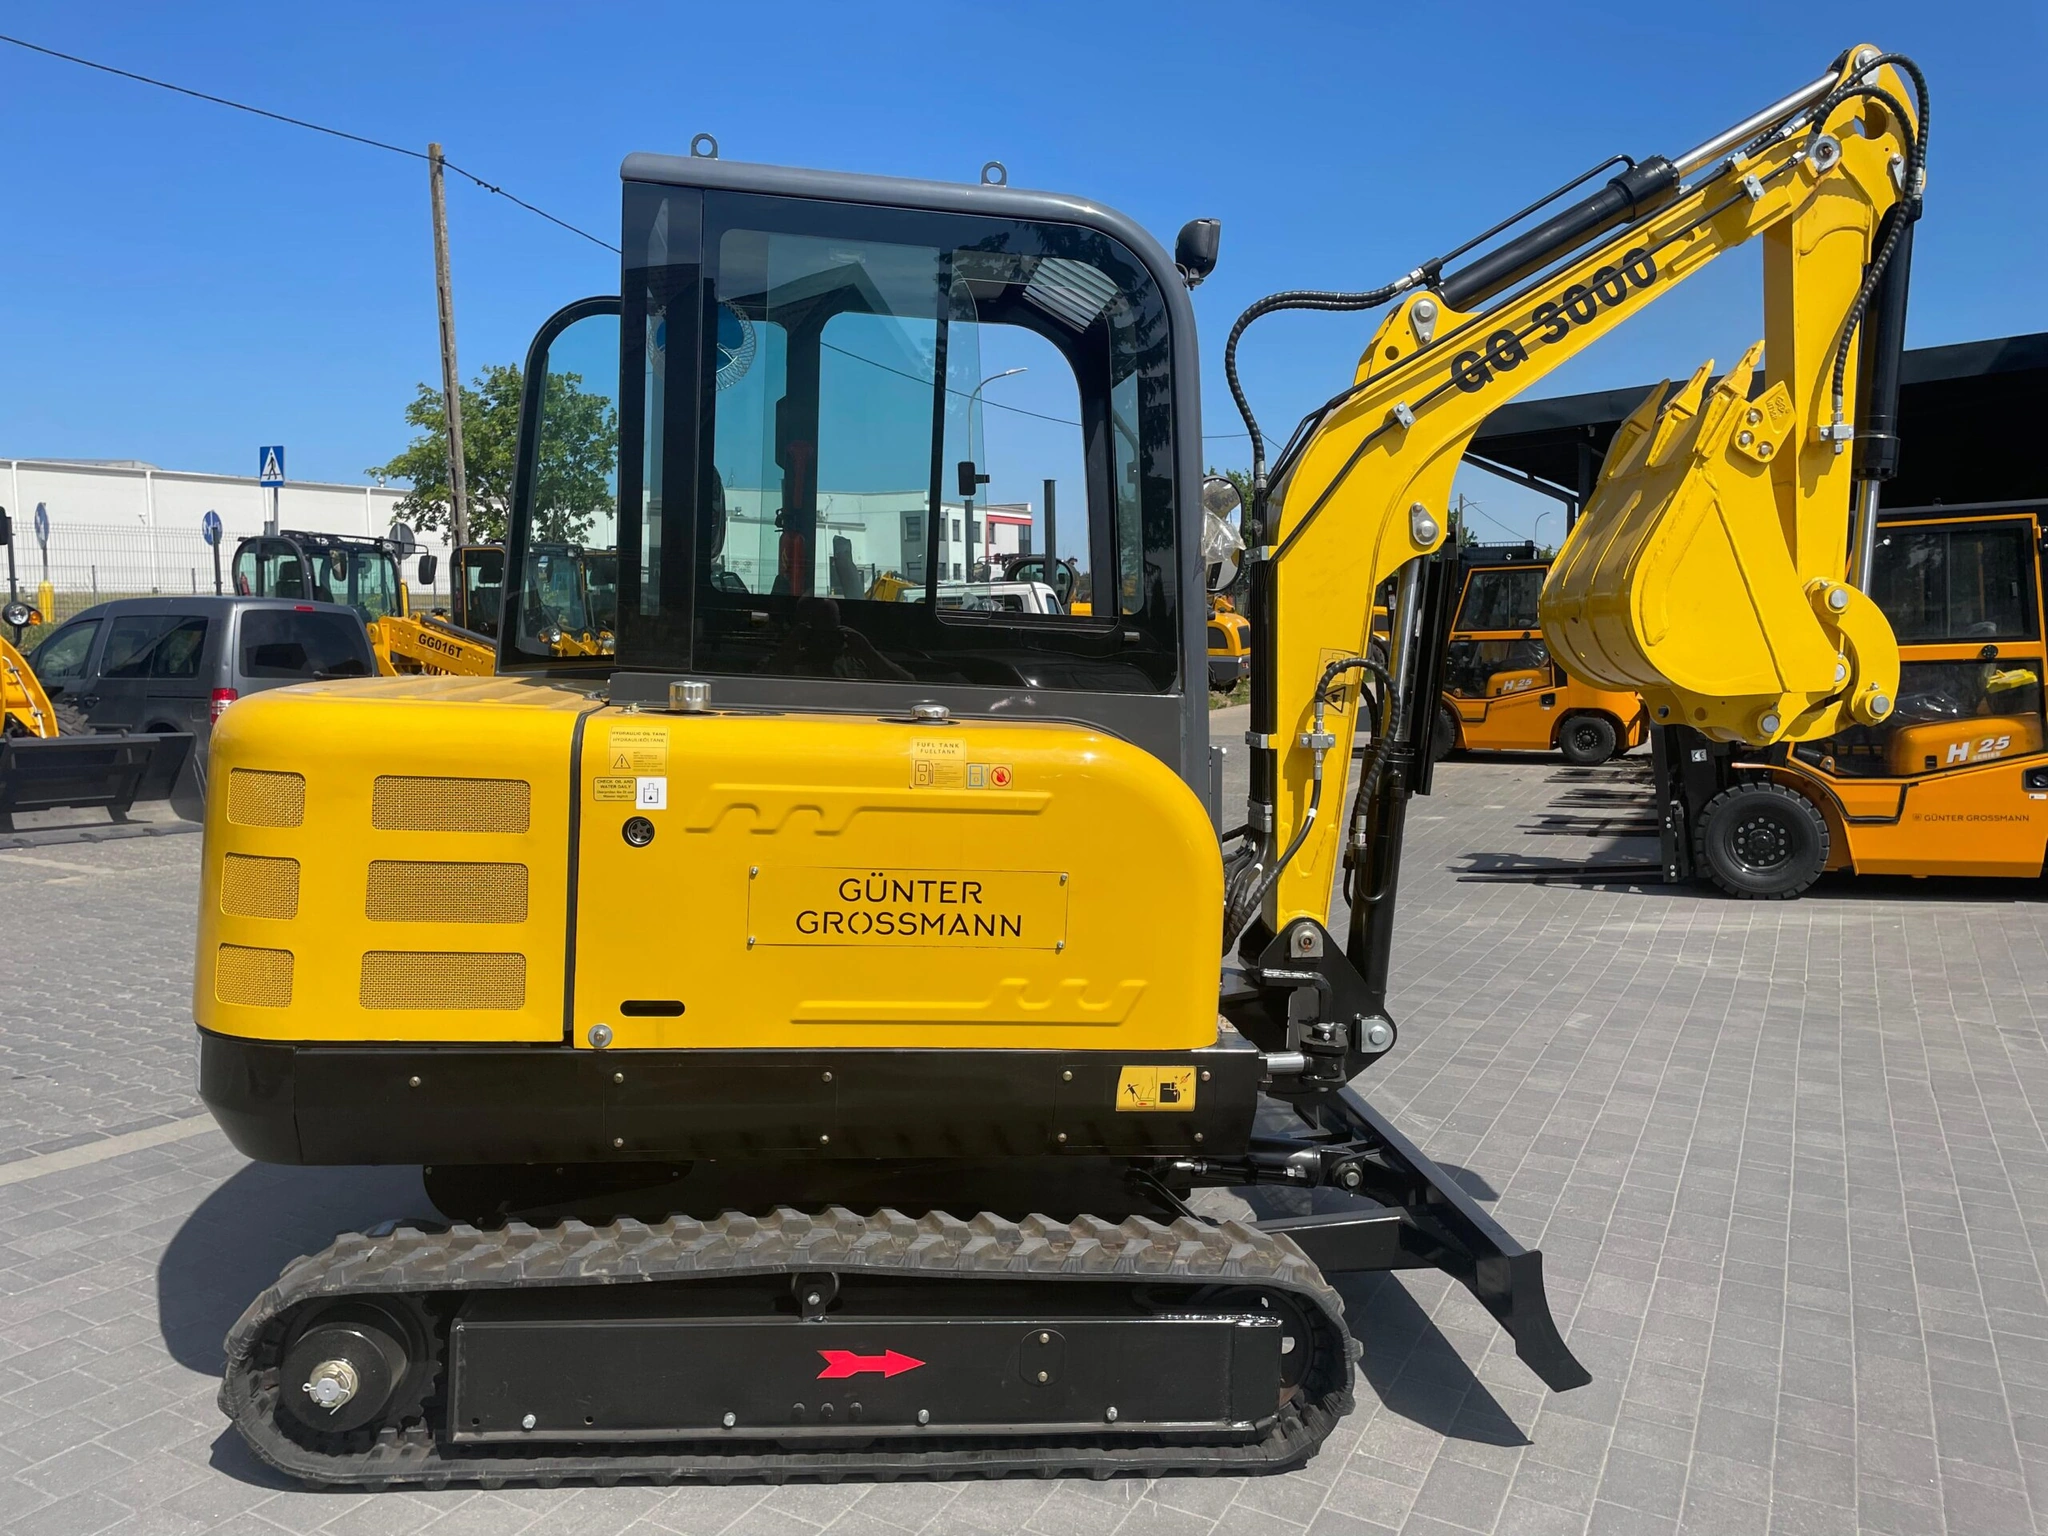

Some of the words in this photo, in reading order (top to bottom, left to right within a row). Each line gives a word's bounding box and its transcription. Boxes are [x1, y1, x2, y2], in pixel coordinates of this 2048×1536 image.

[1450, 329, 1529, 393] GG
[1531, 247, 1657, 344] 3000
[418, 633, 463, 658] GG016T
[1946, 741, 1970, 763] H
[1978, 735, 2011, 753] 25
[1924, 812, 1964, 822] GÜNTER
[1965, 814, 2030, 822] GROSSMANN
[838, 872, 983, 904] GÜNTER
[795, 910, 1022, 937] GROSSMANN
